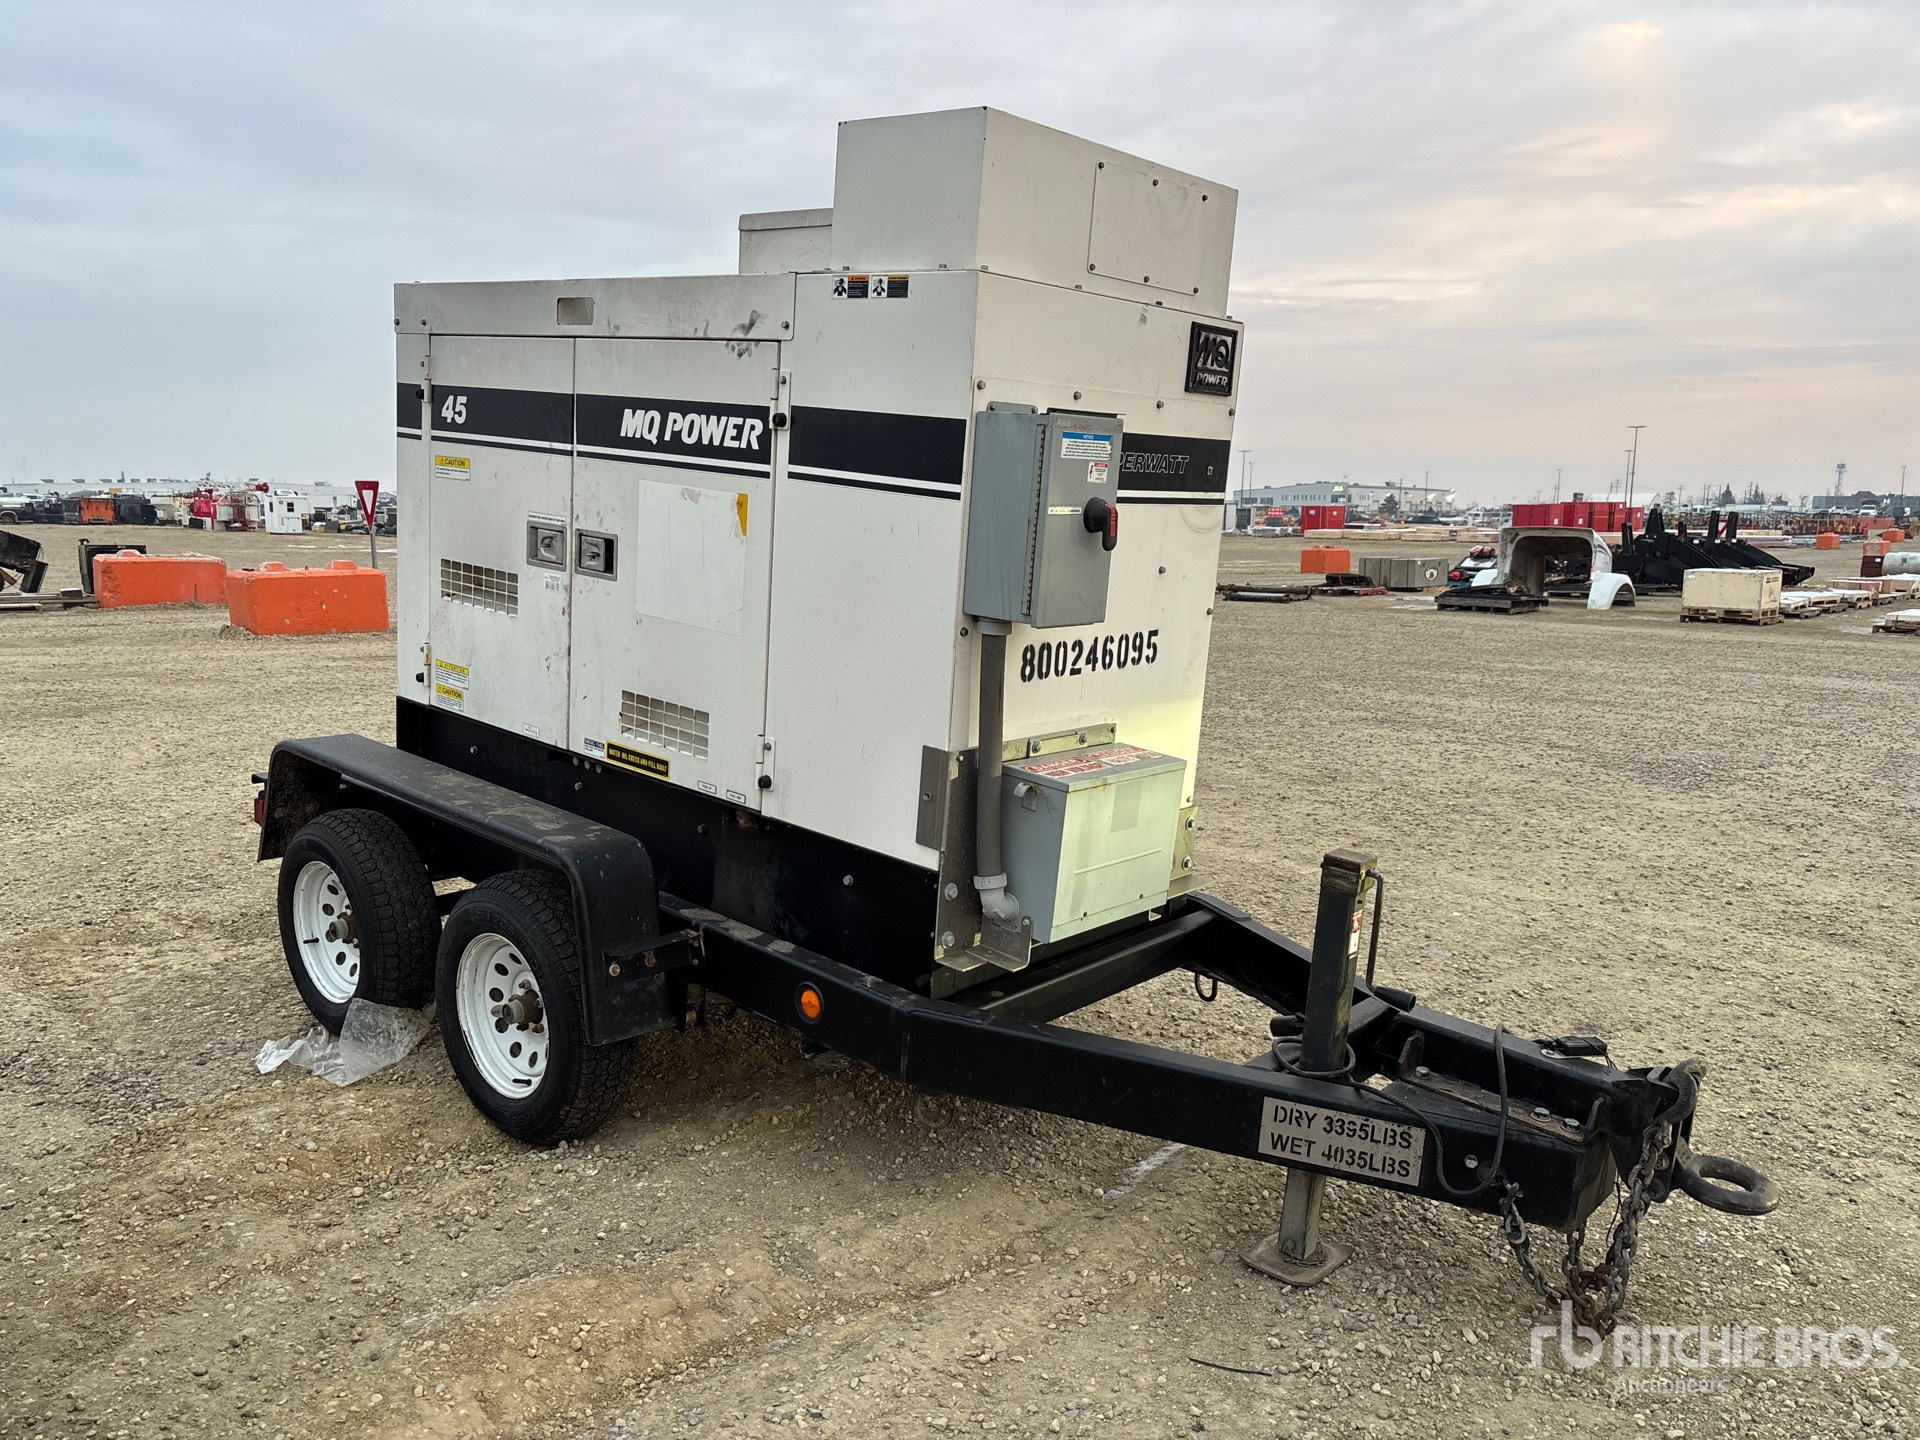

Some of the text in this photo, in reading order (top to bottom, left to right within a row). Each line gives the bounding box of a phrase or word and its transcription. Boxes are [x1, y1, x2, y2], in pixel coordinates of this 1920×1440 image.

[1196, 331, 1230, 371] MQ
[1196, 372, 1229, 386] POWER
[441, 394, 468, 425] 45
[619, 408, 764, 450] MQ POWER
[444, 458, 466, 467] CAUTION
[1020, 629, 1159, 683] 800246095
[442, 688, 462, 698] CAUTION
[1273, 1105, 1318, 1130] DRY
[1270, 1131, 1317, 1158] WET
[1321, 1144, 1411, 1178] 4035LBS
